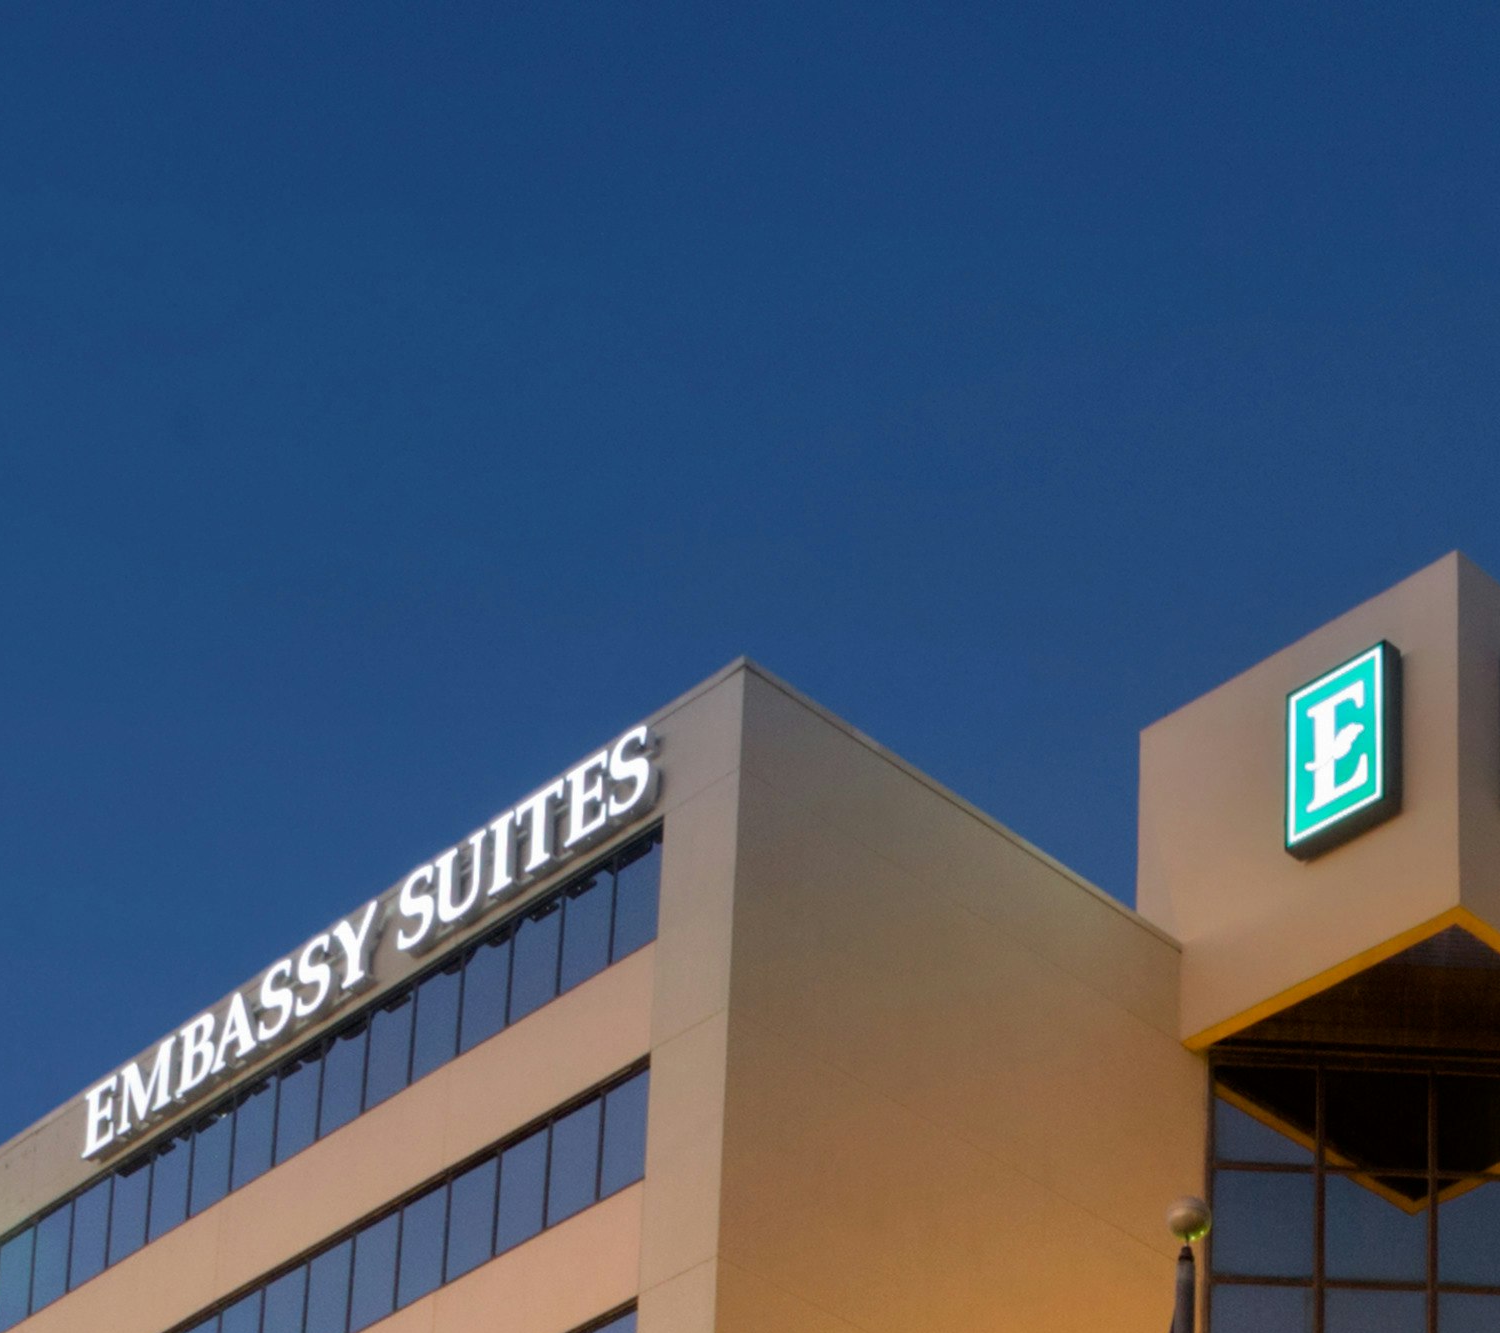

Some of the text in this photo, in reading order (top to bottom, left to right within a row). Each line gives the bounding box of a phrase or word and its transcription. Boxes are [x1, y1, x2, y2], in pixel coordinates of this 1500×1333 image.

[1305, 680, 1369, 813] E
[81, 725, 651, 1159] EMBASSY SUITES
